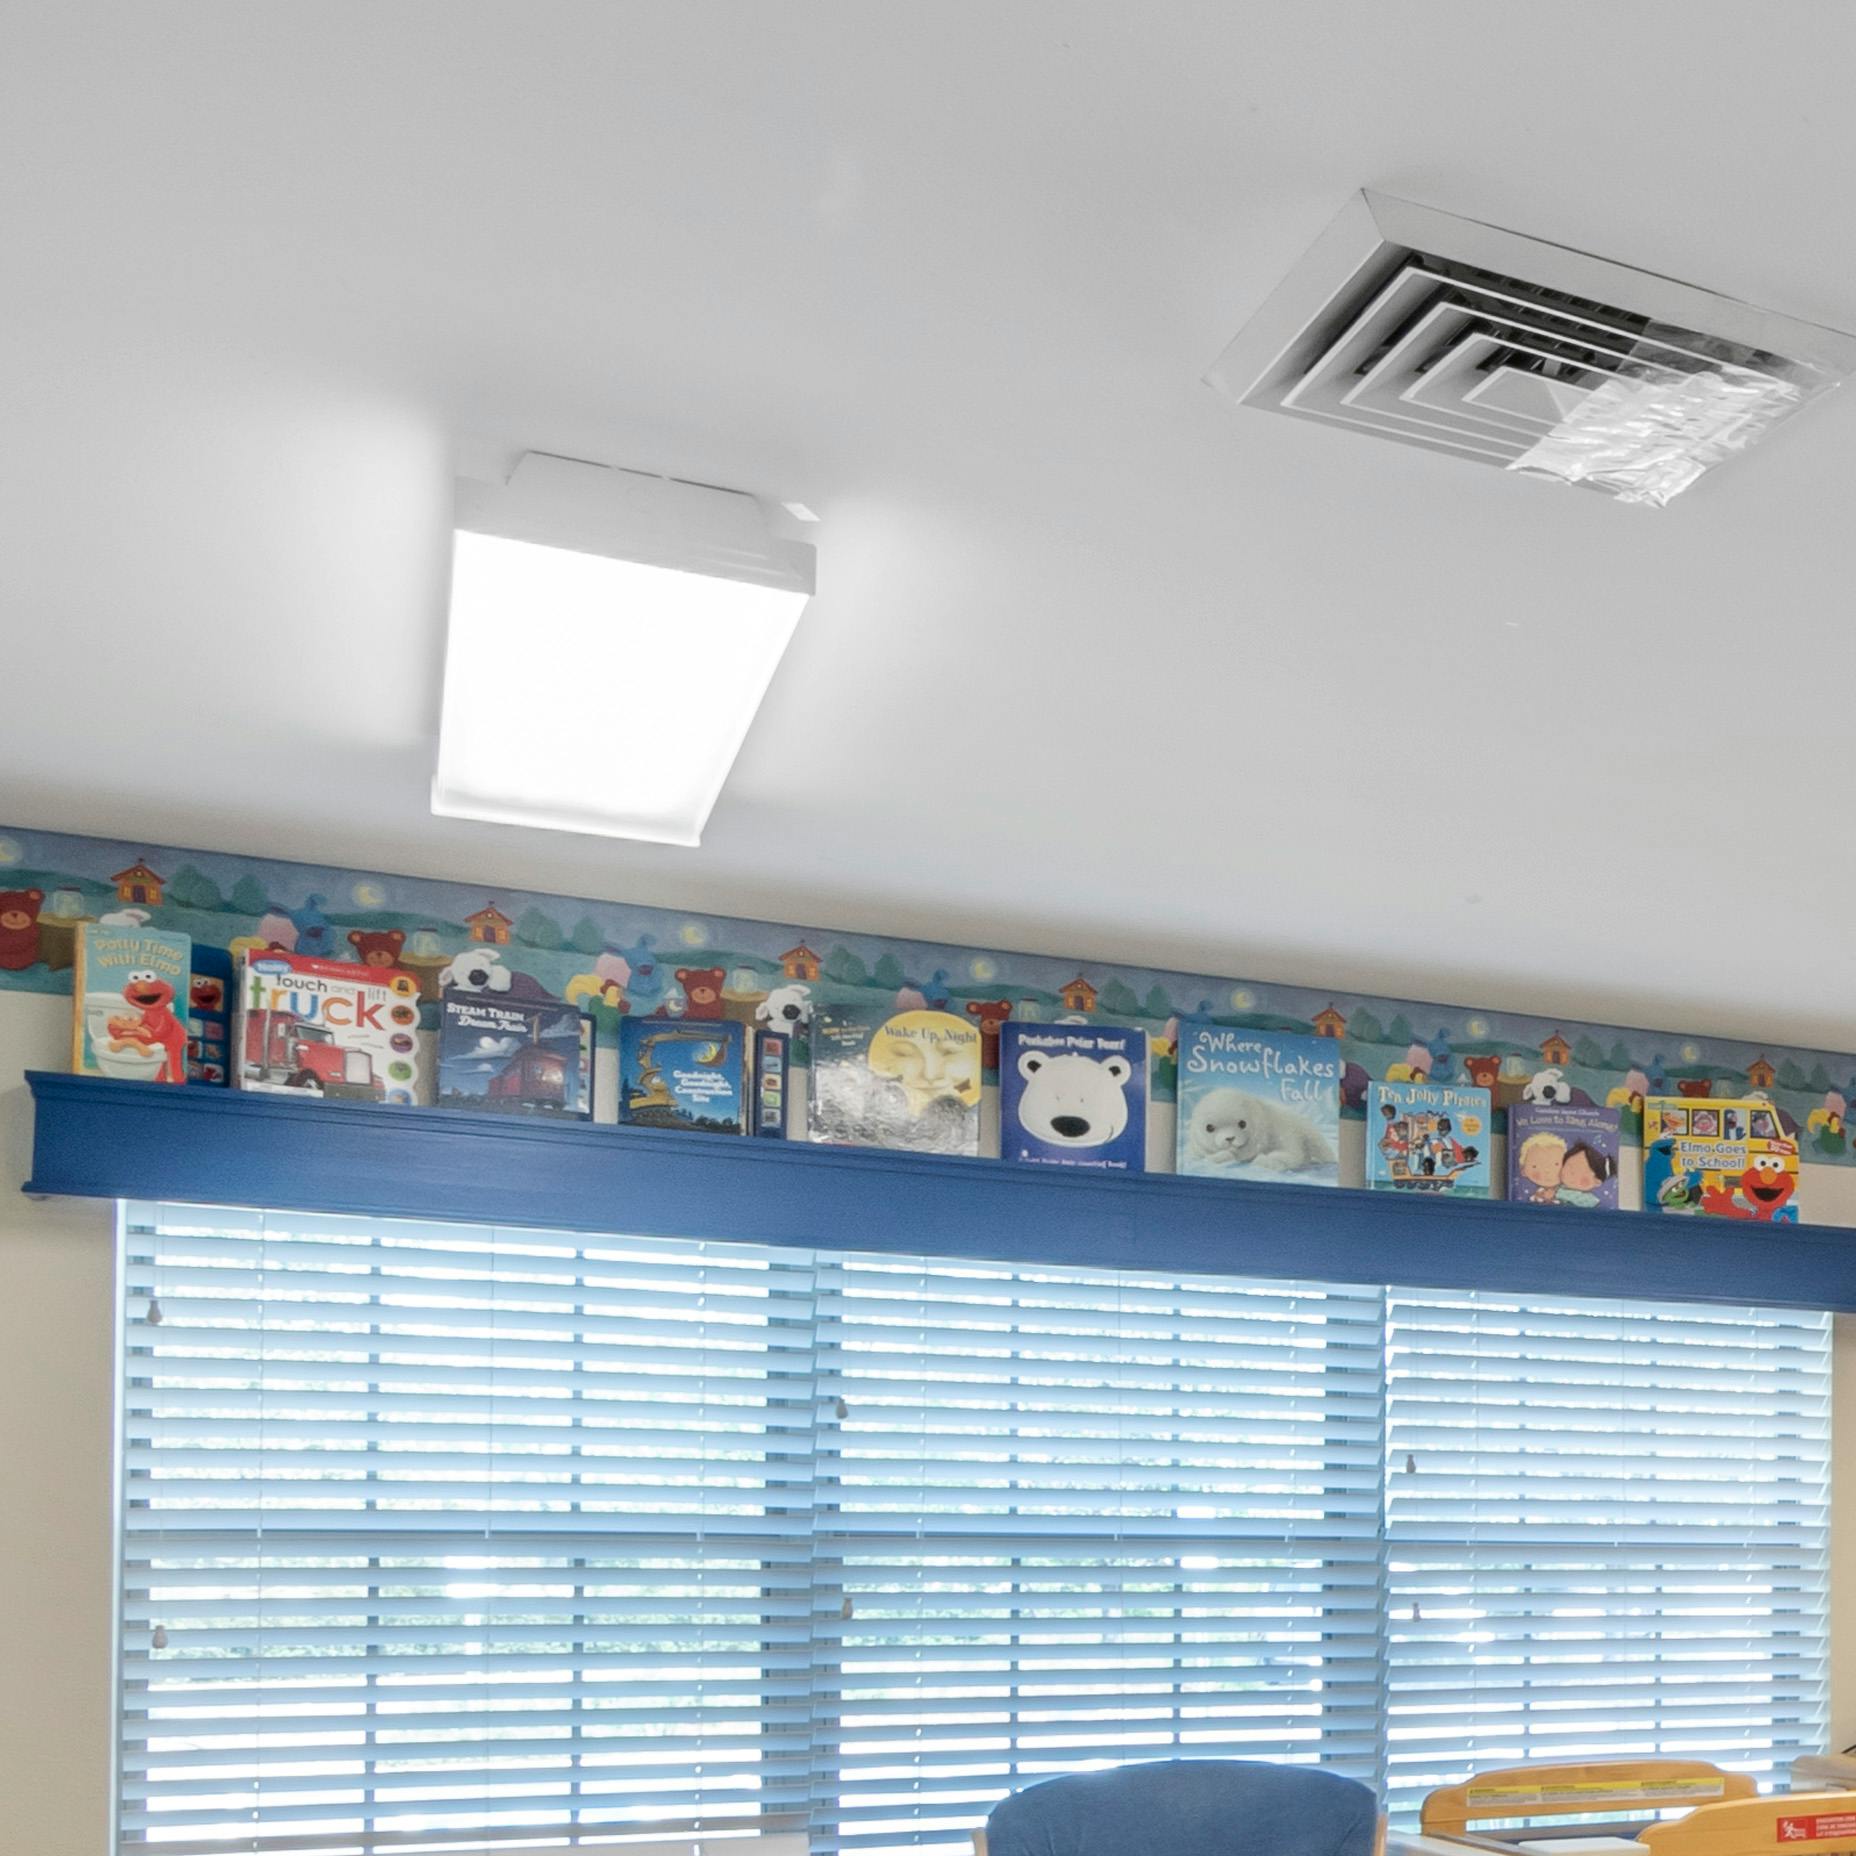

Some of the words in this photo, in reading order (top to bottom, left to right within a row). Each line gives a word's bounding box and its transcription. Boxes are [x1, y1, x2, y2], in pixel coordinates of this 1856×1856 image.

[96, 938, 140, 951] Potty
[144, 939, 184, 961] Time
[141, 955, 181, 976] Elmo
[250, 976, 386, 1031] truck
[884, 1026, 919, 1039] Wake
[943, 1029, 978, 1045] Night
[1199, 1031, 1262, 1053] Where
[1186, 1044, 1335, 1079] Snowflakes
[1281, 1078, 1322, 1101] Fall
[1377, 1086, 1402, 1104] Ten
[1406, 1088, 1438, 1105] Jolly
[1442, 1089, 1488, 1107] Pirates
[1680, 1141, 1712, 1154] Elmo
[1715, 1142, 1747, 1155] Goes
[1681, 1157, 1694, 1168] to
[1698, 1156, 1746, 1169] School!
